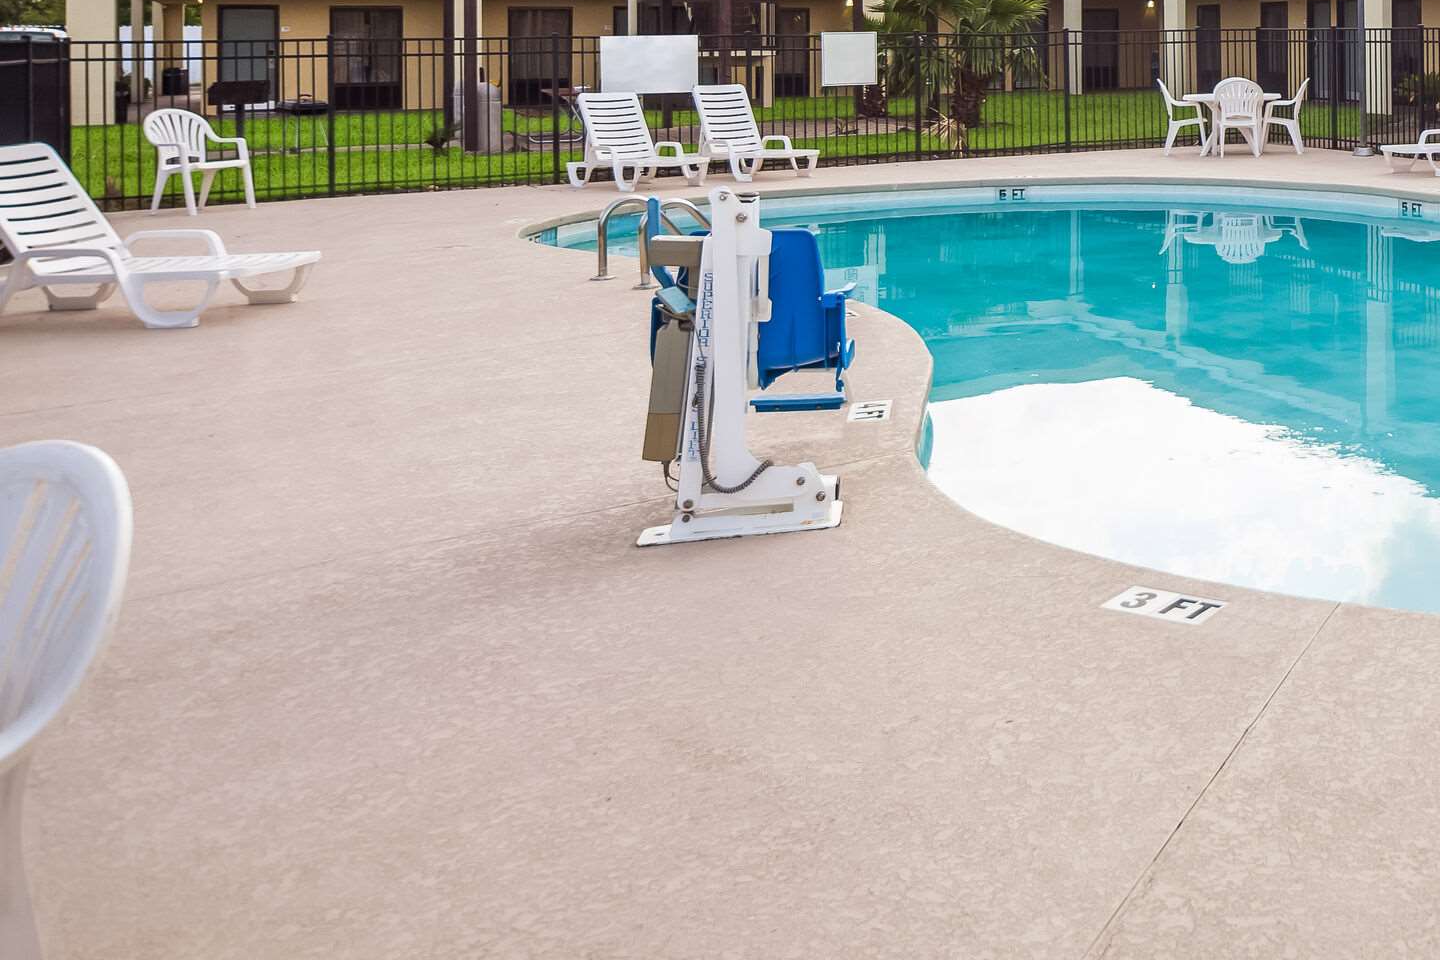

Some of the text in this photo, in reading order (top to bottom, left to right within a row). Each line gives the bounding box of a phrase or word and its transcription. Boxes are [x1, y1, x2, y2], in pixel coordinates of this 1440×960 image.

[1012, 188, 1025, 200] FT
[1411, 202, 1422, 217] FT
[699, 272, 713, 347] SUPERIOR
[1120, 592, 1222, 619] 3 FT
